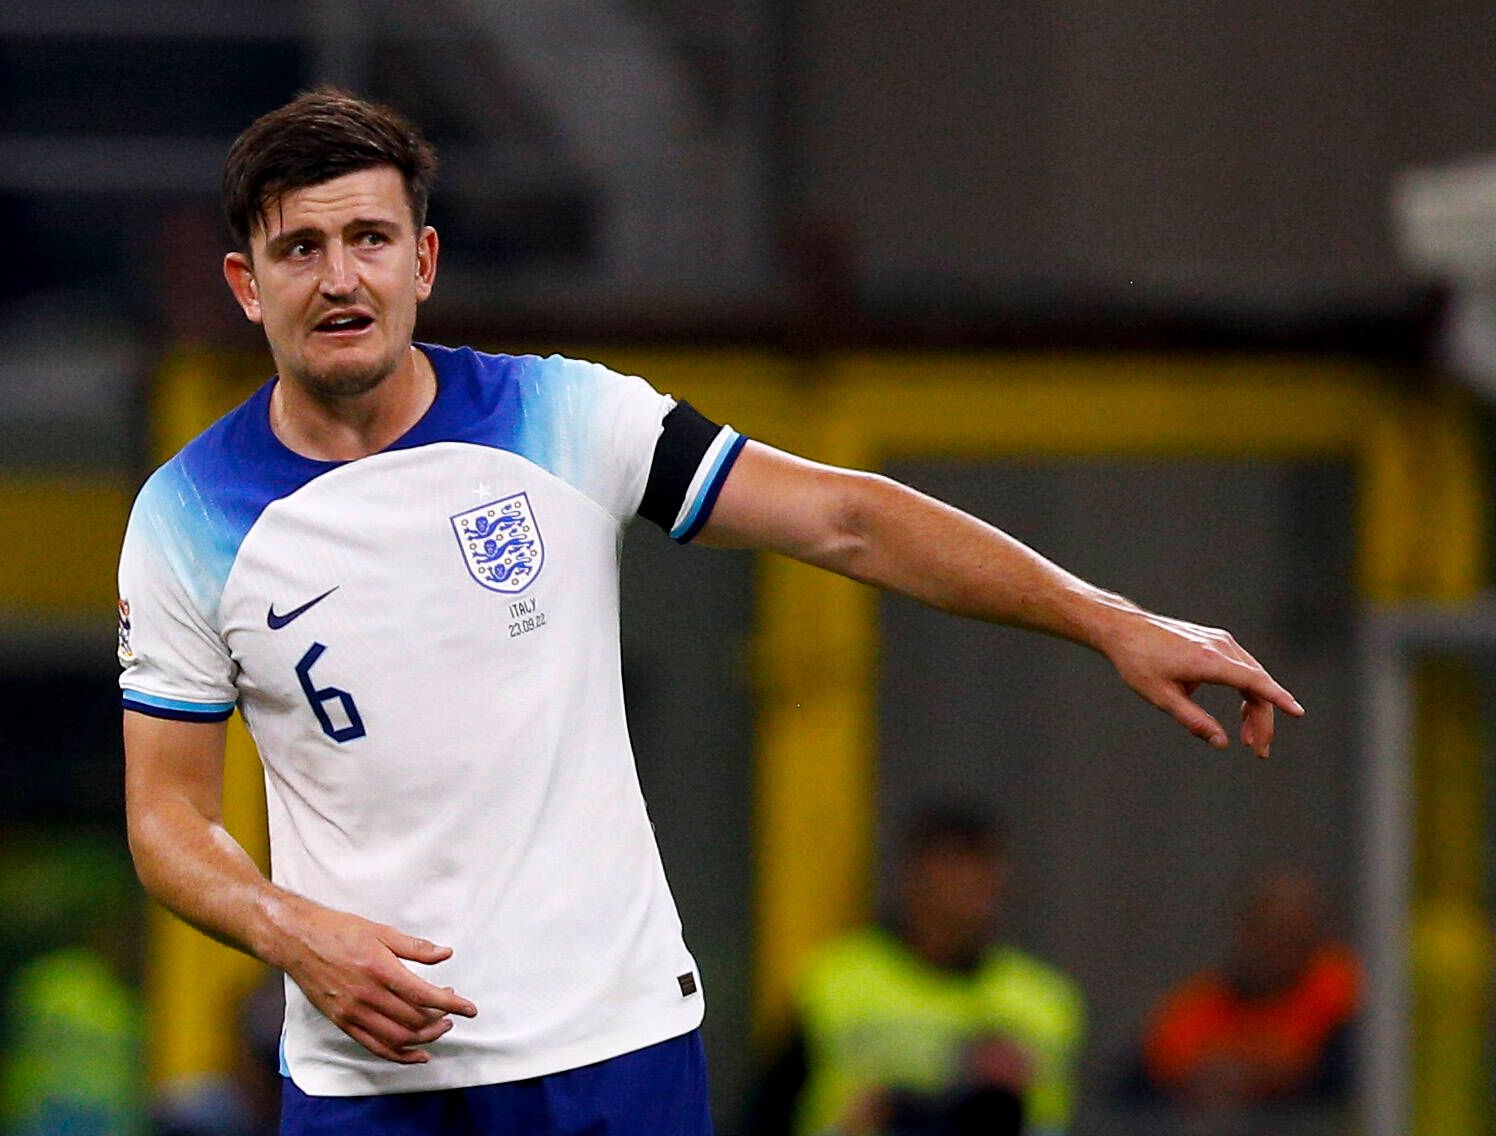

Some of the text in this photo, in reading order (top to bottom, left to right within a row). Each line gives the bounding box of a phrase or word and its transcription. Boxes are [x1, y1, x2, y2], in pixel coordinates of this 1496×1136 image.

[508, 597, 536, 619] ITALY
[508, 612, 546, 638] 23.09.22
[294, 640, 367, 744] 6
